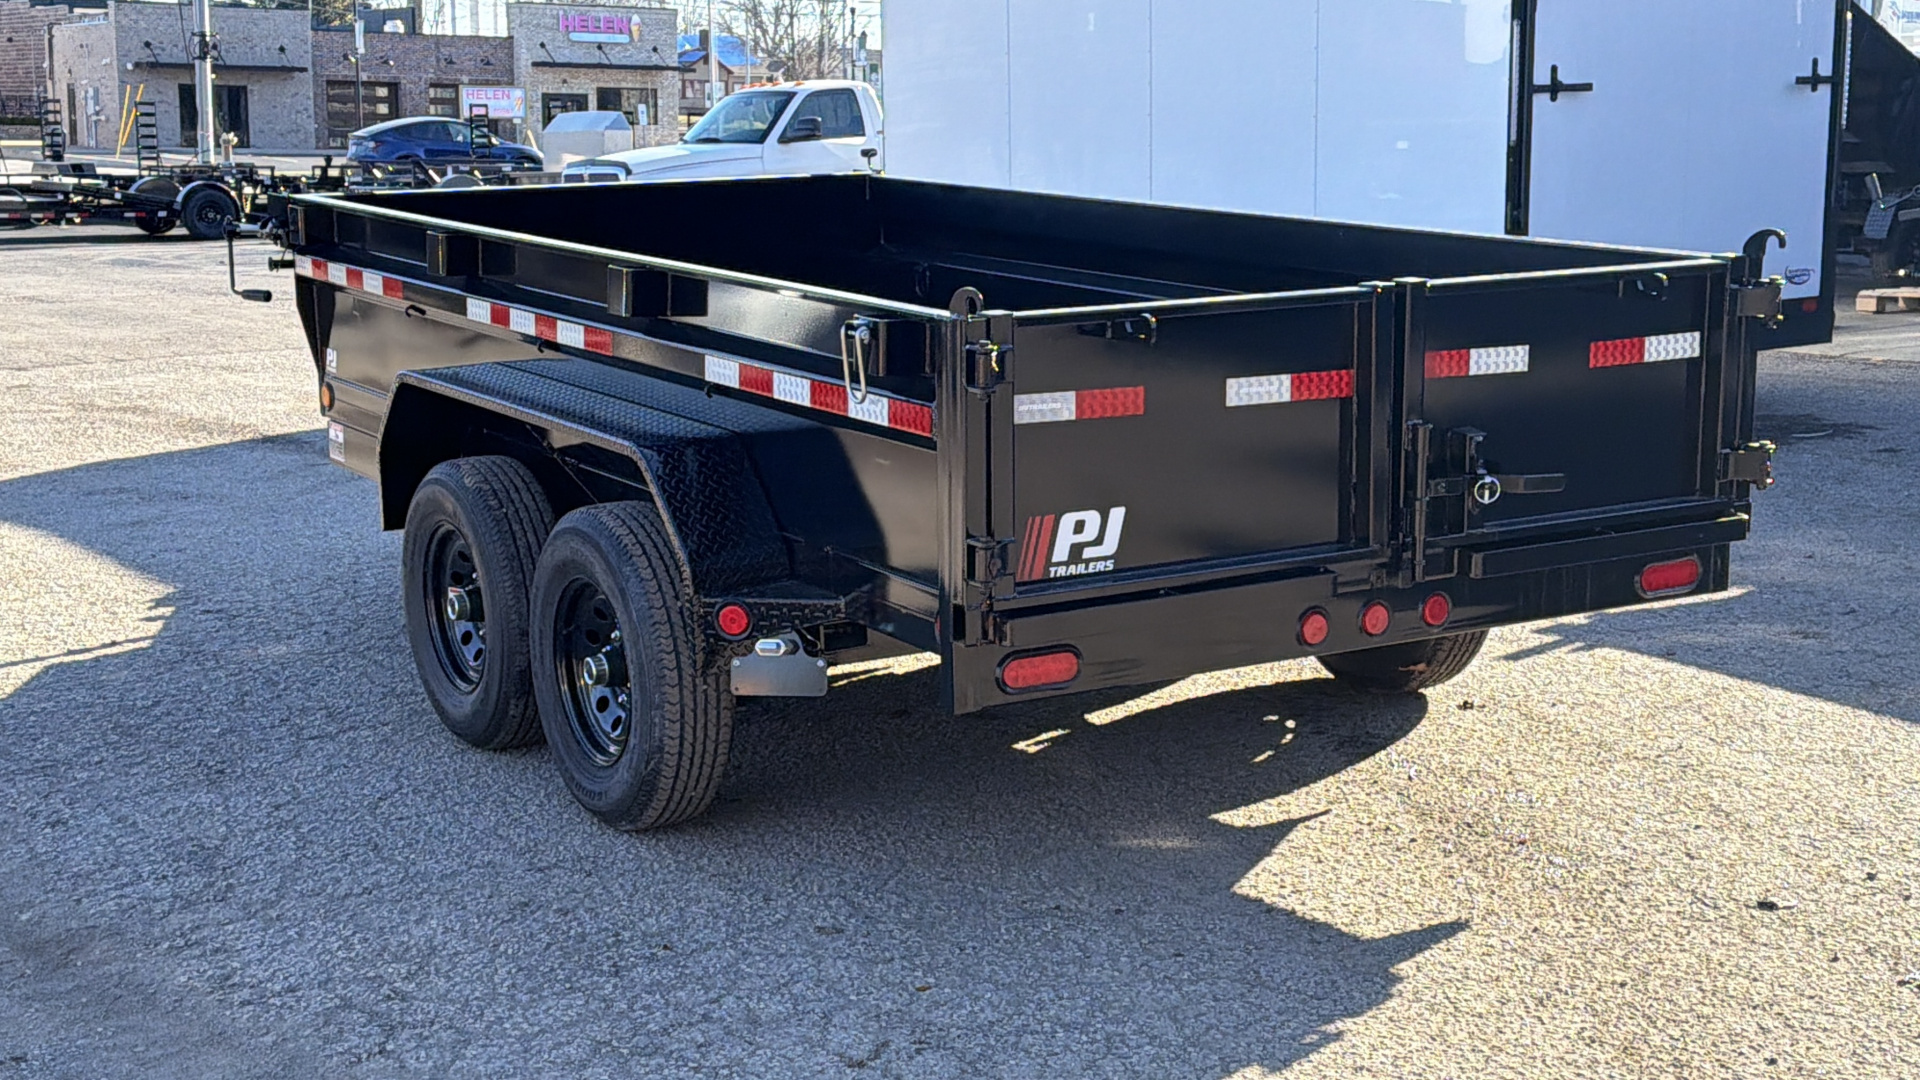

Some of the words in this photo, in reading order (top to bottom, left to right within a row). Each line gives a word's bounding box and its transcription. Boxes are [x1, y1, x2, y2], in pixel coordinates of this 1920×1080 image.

[560, 13, 630, 34] HELEN
[465, 89, 511, 100] HELEN
[326, 347, 337, 368] PJ
[1051, 506, 1126, 562] PJ
[1049, 559, 1115, 578] TRAILERS
